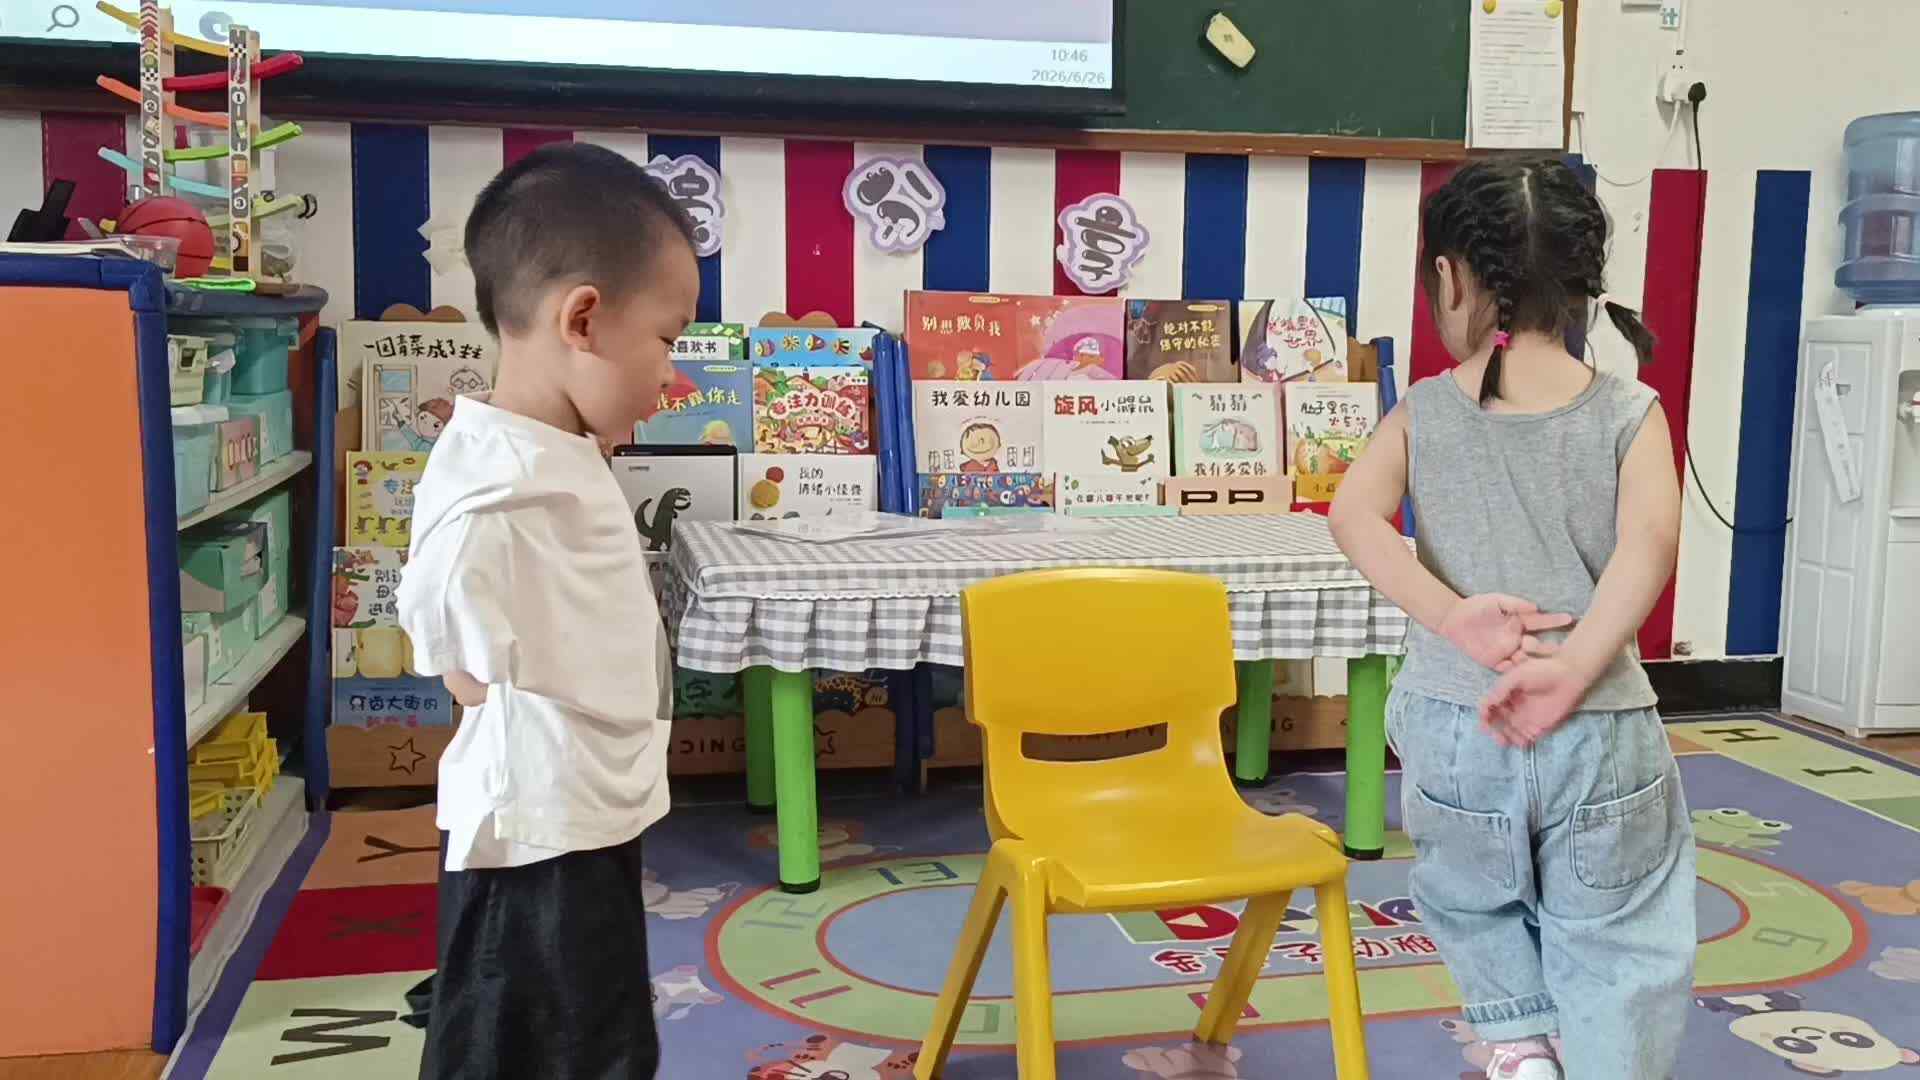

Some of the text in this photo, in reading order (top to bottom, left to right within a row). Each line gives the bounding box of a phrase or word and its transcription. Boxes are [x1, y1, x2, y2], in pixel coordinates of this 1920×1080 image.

[1050, 49, 1088, 62] 10:46
[1031, 69, 1105, 84] 2026/6/26
[932, 391, 1032, 407] 我爱幼儿园
[799, 466, 824, 480] 我的
[356, 834, 440, 863] Y
